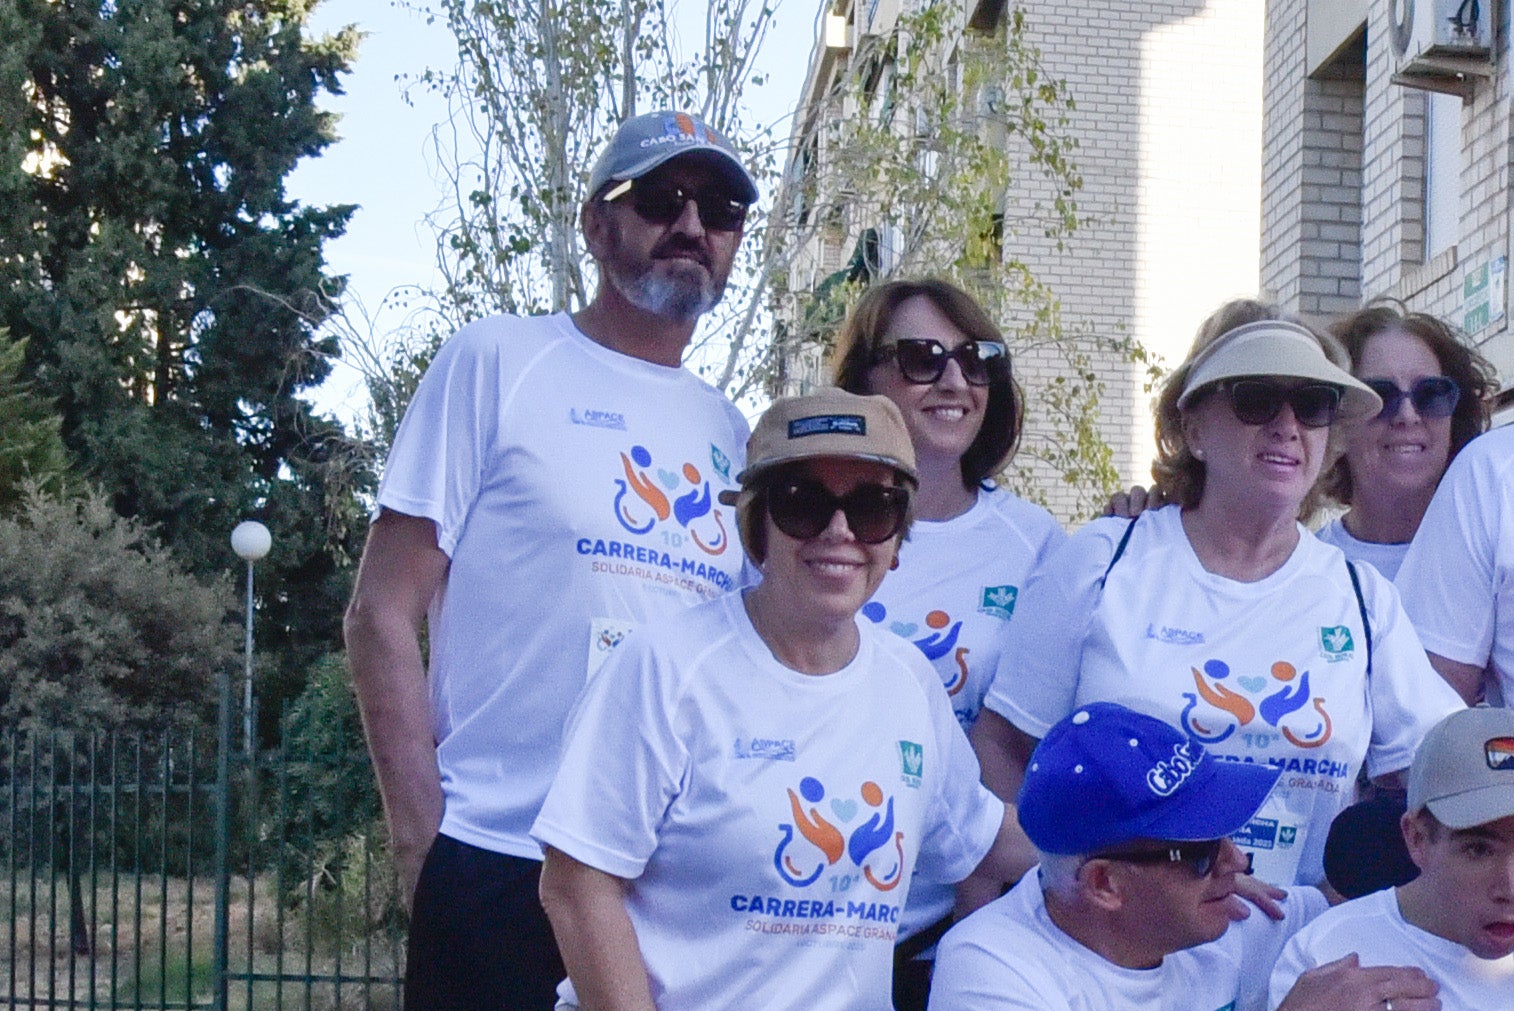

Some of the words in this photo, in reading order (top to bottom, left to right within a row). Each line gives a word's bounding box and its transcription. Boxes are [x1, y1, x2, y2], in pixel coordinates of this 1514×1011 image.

[576, 538, 734, 592] CARRERA-MARCH
[591, 561, 652, 580] SOLIDARIA
[730, 894, 899, 924] CARRERA-MARC
[746, 919, 811, 936] SOLIDARIA
[811, 922, 863, 938] ASPACE
